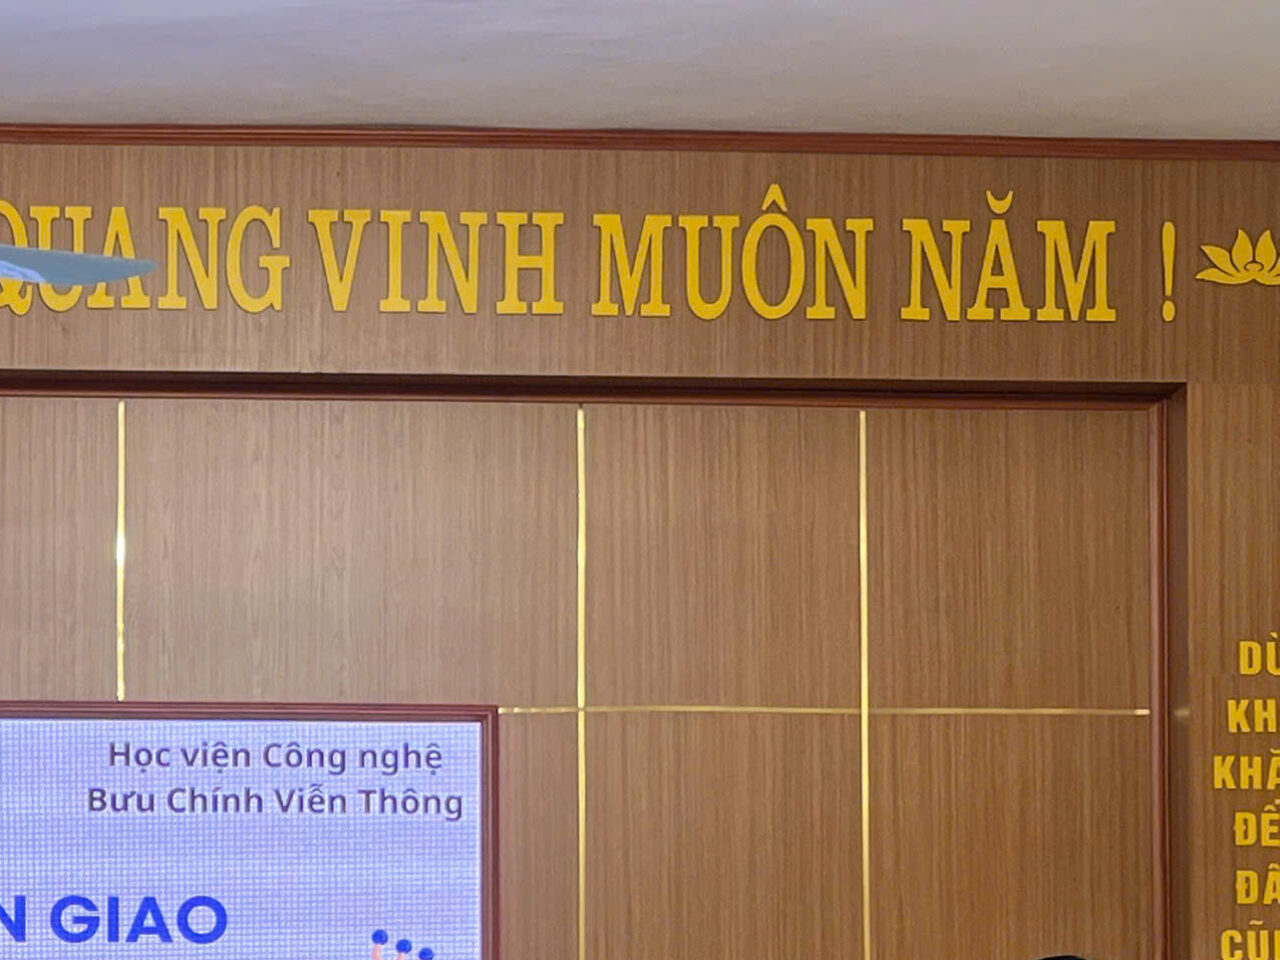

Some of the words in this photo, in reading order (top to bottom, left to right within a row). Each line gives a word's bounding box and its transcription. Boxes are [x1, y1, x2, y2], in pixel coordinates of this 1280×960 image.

[308, 208, 564, 313] VINH
[591, 183, 874, 320] MUÔN
[900, 190, 1117, 322] NĂM
[109, 742, 170, 774] Học
[181, 742, 251, 774] viện
[263, 742, 347, 775] Công
[360, 743, 442, 775] nghệ
[89, 788, 155, 813] Bưu
[167, 787, 263, 814] Chính
[275, 783, 347, 814] Viễn
[359, 788, 463, 821] Thông
[50, 895, 228, 944] GIAO
